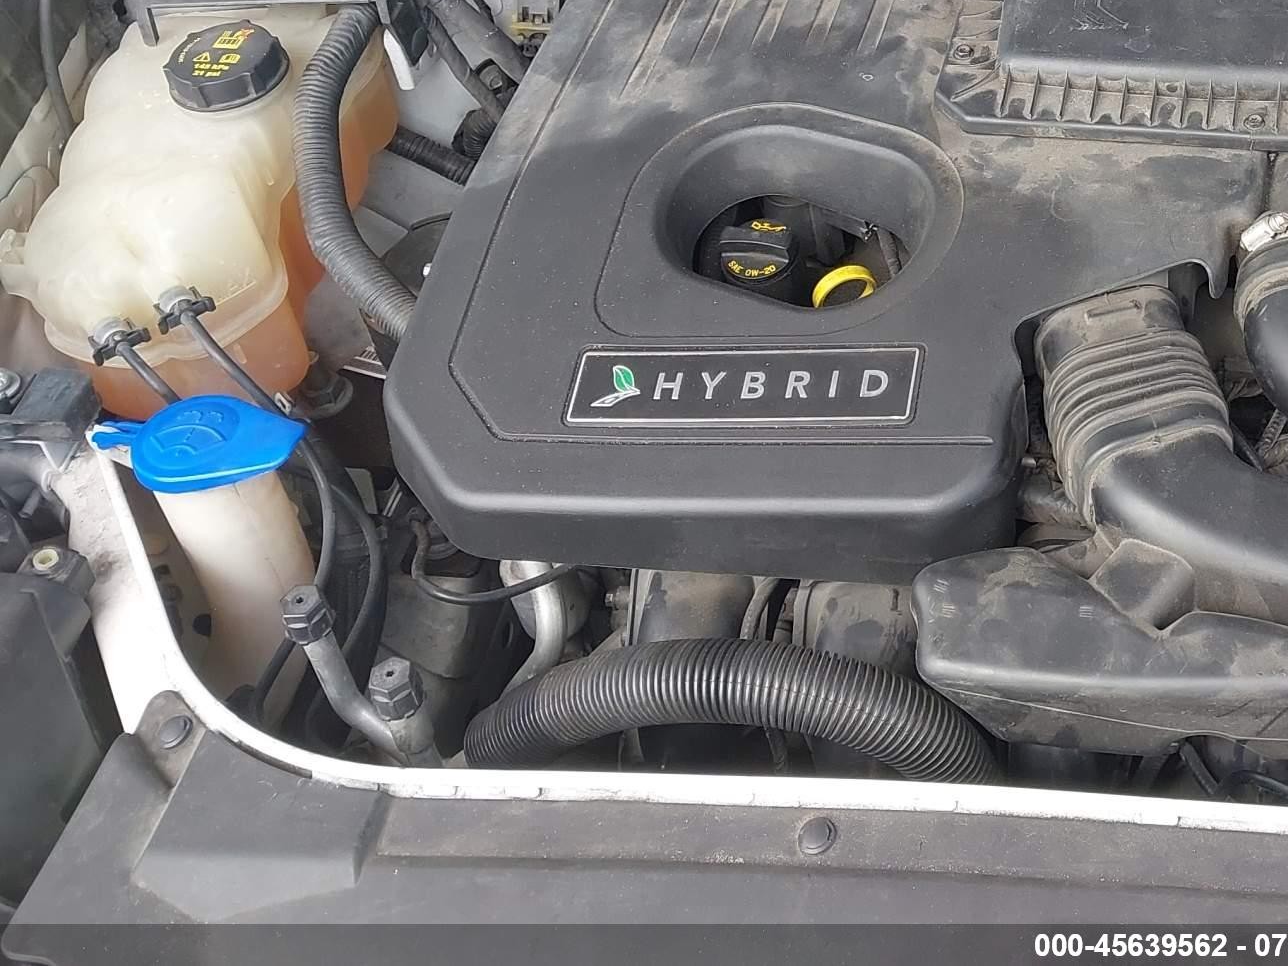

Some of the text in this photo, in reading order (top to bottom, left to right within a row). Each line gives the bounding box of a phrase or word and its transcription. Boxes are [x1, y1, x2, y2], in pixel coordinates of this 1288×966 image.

[728, 259, 776, 277] SAE 0W-20
[653, 369, 889, 400] HYBRID
